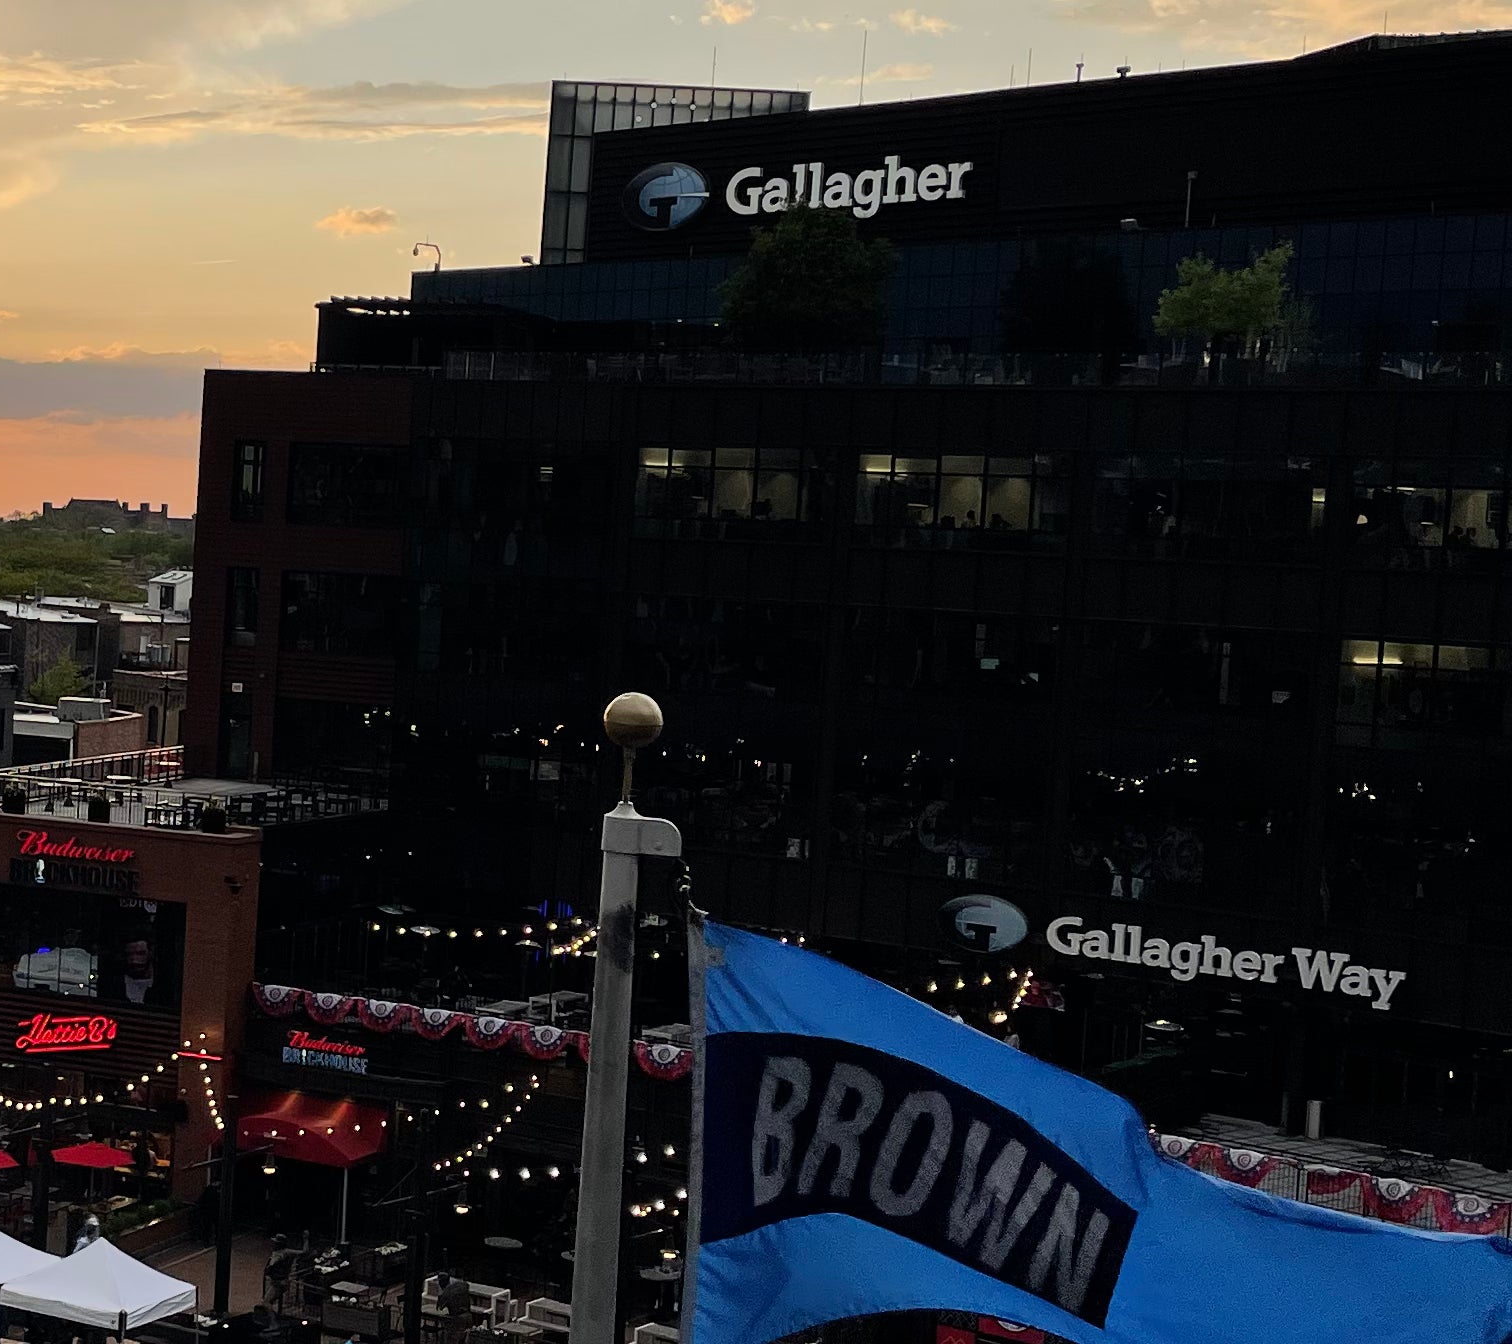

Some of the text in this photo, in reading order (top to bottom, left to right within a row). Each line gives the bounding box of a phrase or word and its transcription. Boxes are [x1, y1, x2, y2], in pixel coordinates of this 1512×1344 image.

[726, 155, 974, 219] Gallagher
[16, 828, 136, 863] Budweiser
[1046, 916, 1406, 1010] Gallagher Way
[752, 1056, 1110, 1314] BROWN
